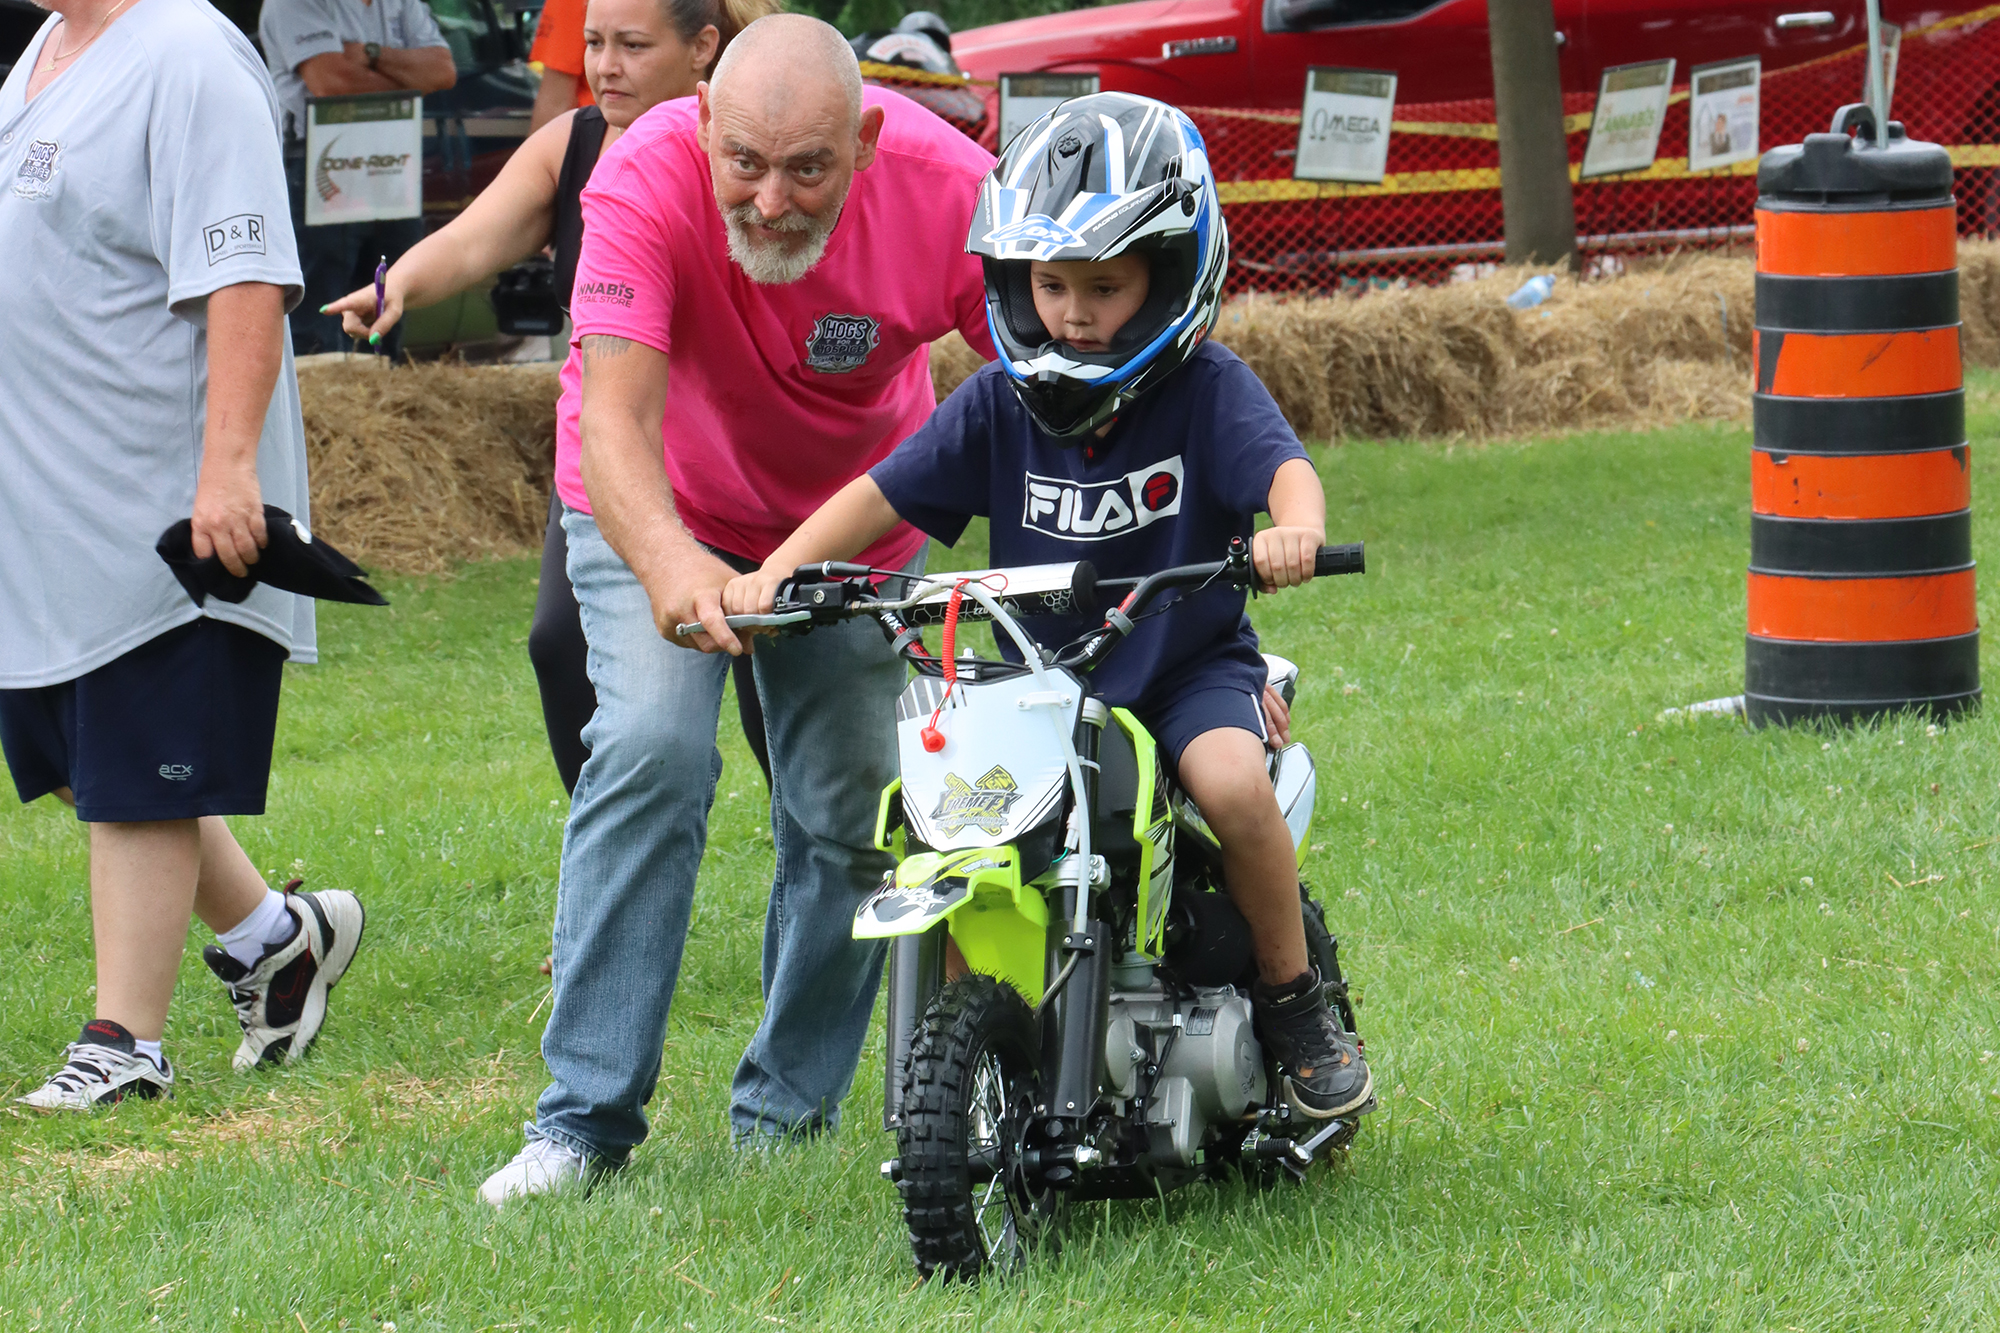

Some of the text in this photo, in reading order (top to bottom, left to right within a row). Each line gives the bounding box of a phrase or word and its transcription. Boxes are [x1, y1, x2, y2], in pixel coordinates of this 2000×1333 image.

[28, 142, 57, 163] HOGS
[1092, 190, 1155, 233] RACING EQUIPMENT
[209, 219, 261, 252] D & R
[599, 295, 632, 308] STORE
[823, 319, 868, 340] HOGS
[814, 343, 867, 355] HOSPICE
[1029, 482, 1133, 533] FILA
